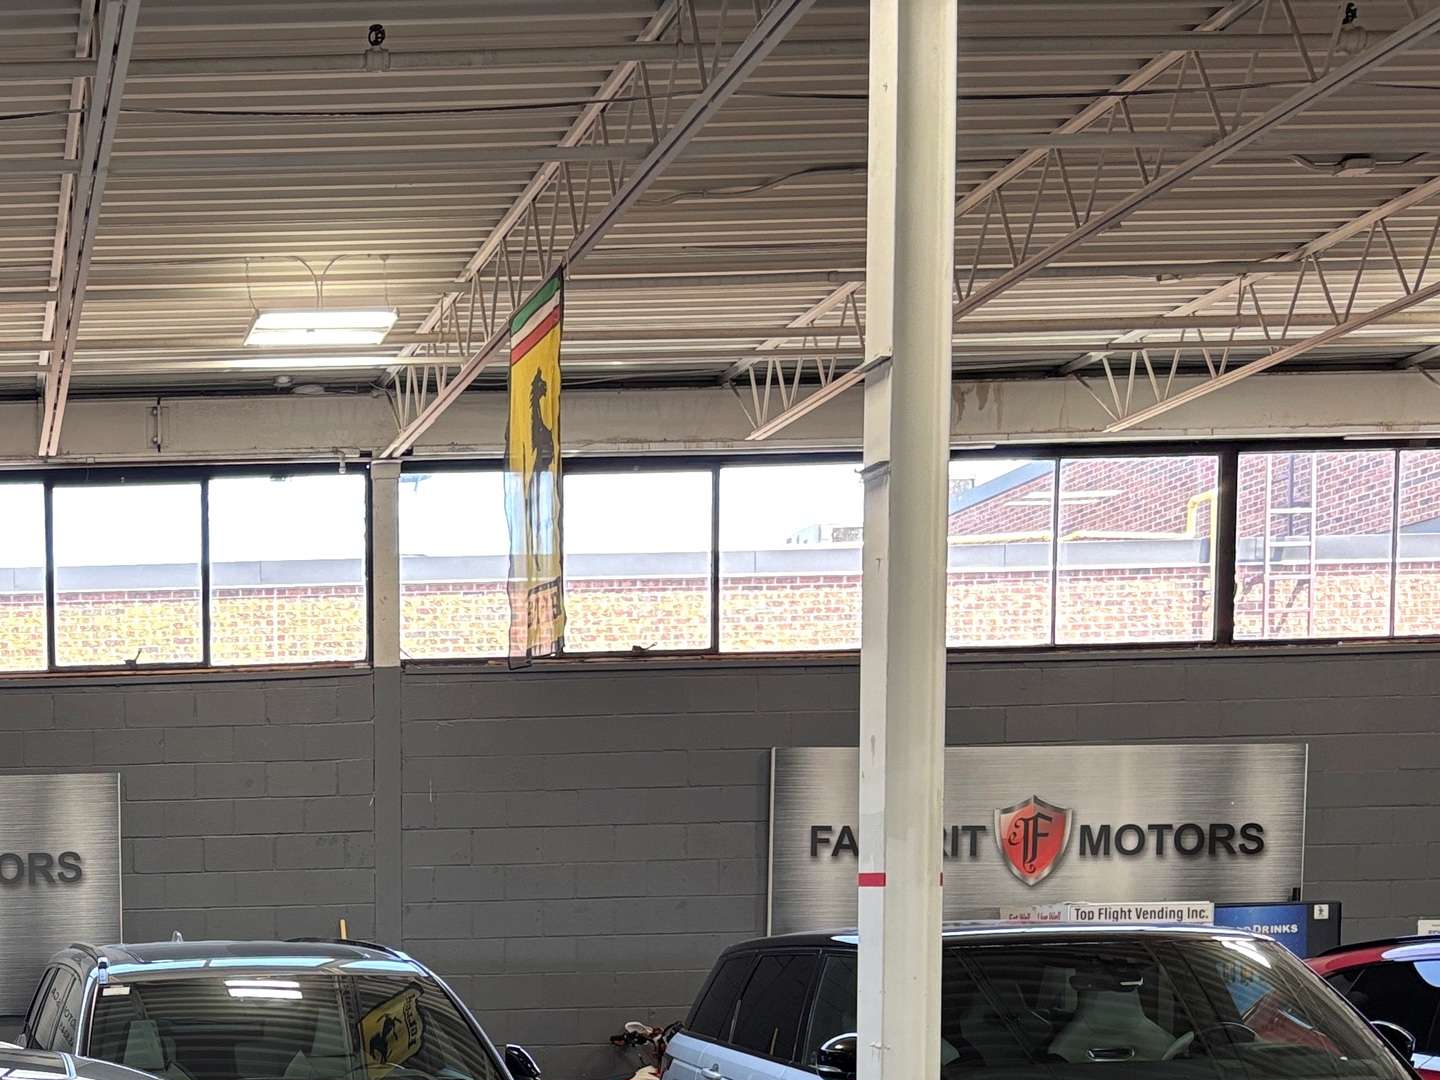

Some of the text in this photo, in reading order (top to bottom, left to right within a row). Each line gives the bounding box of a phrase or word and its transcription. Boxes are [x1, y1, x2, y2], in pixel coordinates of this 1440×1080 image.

[810, 823, 1265, 857] FAIT MOTORS
[1075, 907, 1209, 922] Top Flight Vending Inc.
[1252, 924, 1298, 934] DRINKS
